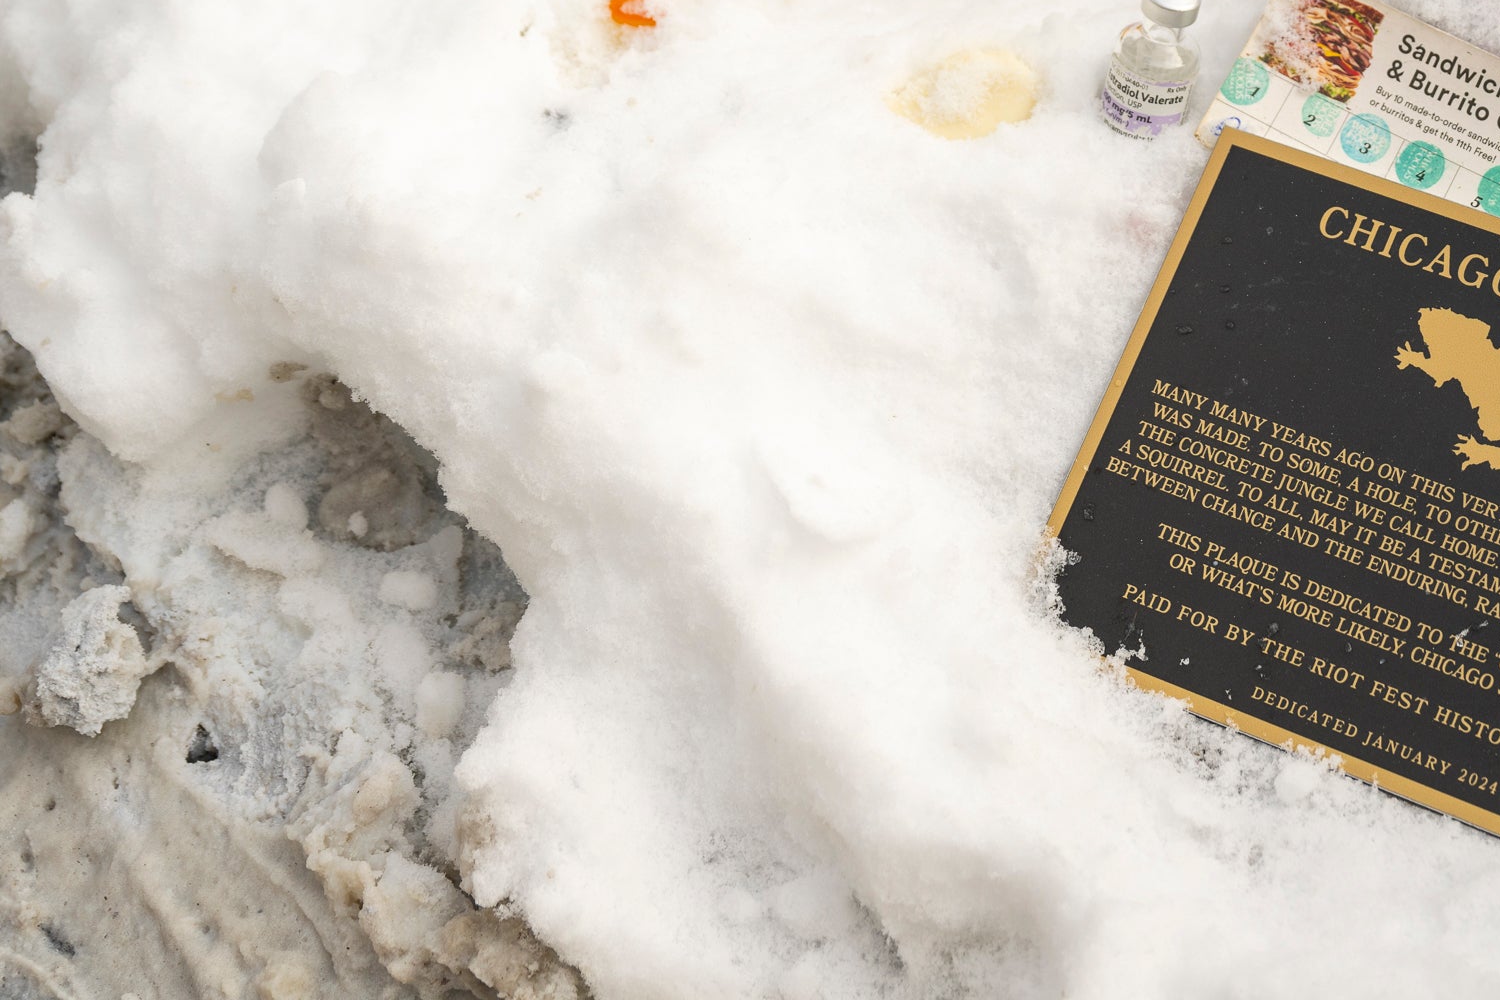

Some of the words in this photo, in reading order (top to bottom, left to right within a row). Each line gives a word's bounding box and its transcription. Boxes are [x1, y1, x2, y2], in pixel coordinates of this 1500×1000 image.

[1136, 115, 1153, 125] mL
[1141, 92, 1185, 106] Valerate
[1303, 114, 1316, 127] 2
[1369, 98, 1381, 108] or
[1381, 101, 1414, 125] burritos
[1415, 119, 1422, 129] &
[1422, 124, 1439, 137] get
[1440, 130, 1455, 144] the
[1456, 138, 1473, 152] 11th
[1475, 147, 1498, 164] Free!
[1375, 85, 1393, 101] Buy
[1393, 94, 1404, 105] 10
[1404, 100, 1467, 134] made-to-order
[1386, 59, 1403, 83] &
[1408, 72, 1490, 122] Burrito
[1359, 142, 1372, 155] 3
[1415, 169, 1426, 182] 4
[1470, 196, 1484, 208] 5
[1152, 379, 1209, 411] MANY
[1209, 400, 1269, 433] MANY
[1270, 421, 1332, 457] YEARS
[1333, 448, 1375, 473] AGO
[1377, 462, 1407, 485] ON
[1411, 473, 1456, 503] THIS
[1153, 401, 1194, 429] WAS
[1195, 418, 1251, 451] MADE.
[1259, 441, 1284, 463] TO
[1286, 452, 1342, 488] SOME,
[1345, 476, 1360, 493] A
[1364, 480, 1417, 515] HOLE,
[1425, 502, 1452, 525] TO
[1106, 455, 1201, 503] BETWEEN
[1201, 492, 1276, 532] CHANCE
[1277, 522, 1320, 548] AND
[1324, 537, 1365, 566] THE
[1365, 554, 1468, 608] ENDURING,
[1119, 439, 1131, 455] A
[1135, 444, 1227, 491] SQUIRREL.
[1237, 480, 1263, 503] TO
[1263, 493, 1303, 520] ALL,
[1309, 508, 1354, 536] MAY
[1353, 525, 1378, 546] IT
[1378, 535, 1407, 557] BE
[1406, 547, 1421, 564] A
[1139, 420, 1177, 447] THE
[1178, 437, 1277, 484] CONCRETE
[1273, 473, 1350, 512] JUNGLE
[1355, 500, 1387, 526] WE
[1389, 515, 1436, 545] CALL
[1440, 533, 1499, 568] HOME.
[1157, 522, 1202, 553] THIS
[1203, 541, 1279, 582] PLAQUE
[1279, 570, 1302, 591] IS
[1302, 579, 1412, 633] DEDICATED
[1417, 621, 1444, 645] TO
[1448, 634, 1490, 664] THE
[1169, 553, 1197, 575] OR
[1276, 593, 1334, 628] MORE
[1335, 616, 1407, 658] LIKELY,
[1410, 646, 1495, 690] CHICAGO
[1122, 583, 1172, 614] PAID
[1176, 604, 1219, 634] FOR
[1224, 623, 1256, 647] BY
[1262, 637, 1305, 668] THE
[1310, 657, 1365, 690] RIOT
[1369, 680, 1429, 715] FEST
[1250, 685, 1358, 738] DEDICATED
[1361, 731, 1452, 775] JANUARY
[1457, 768, 1498, 795] 2024
